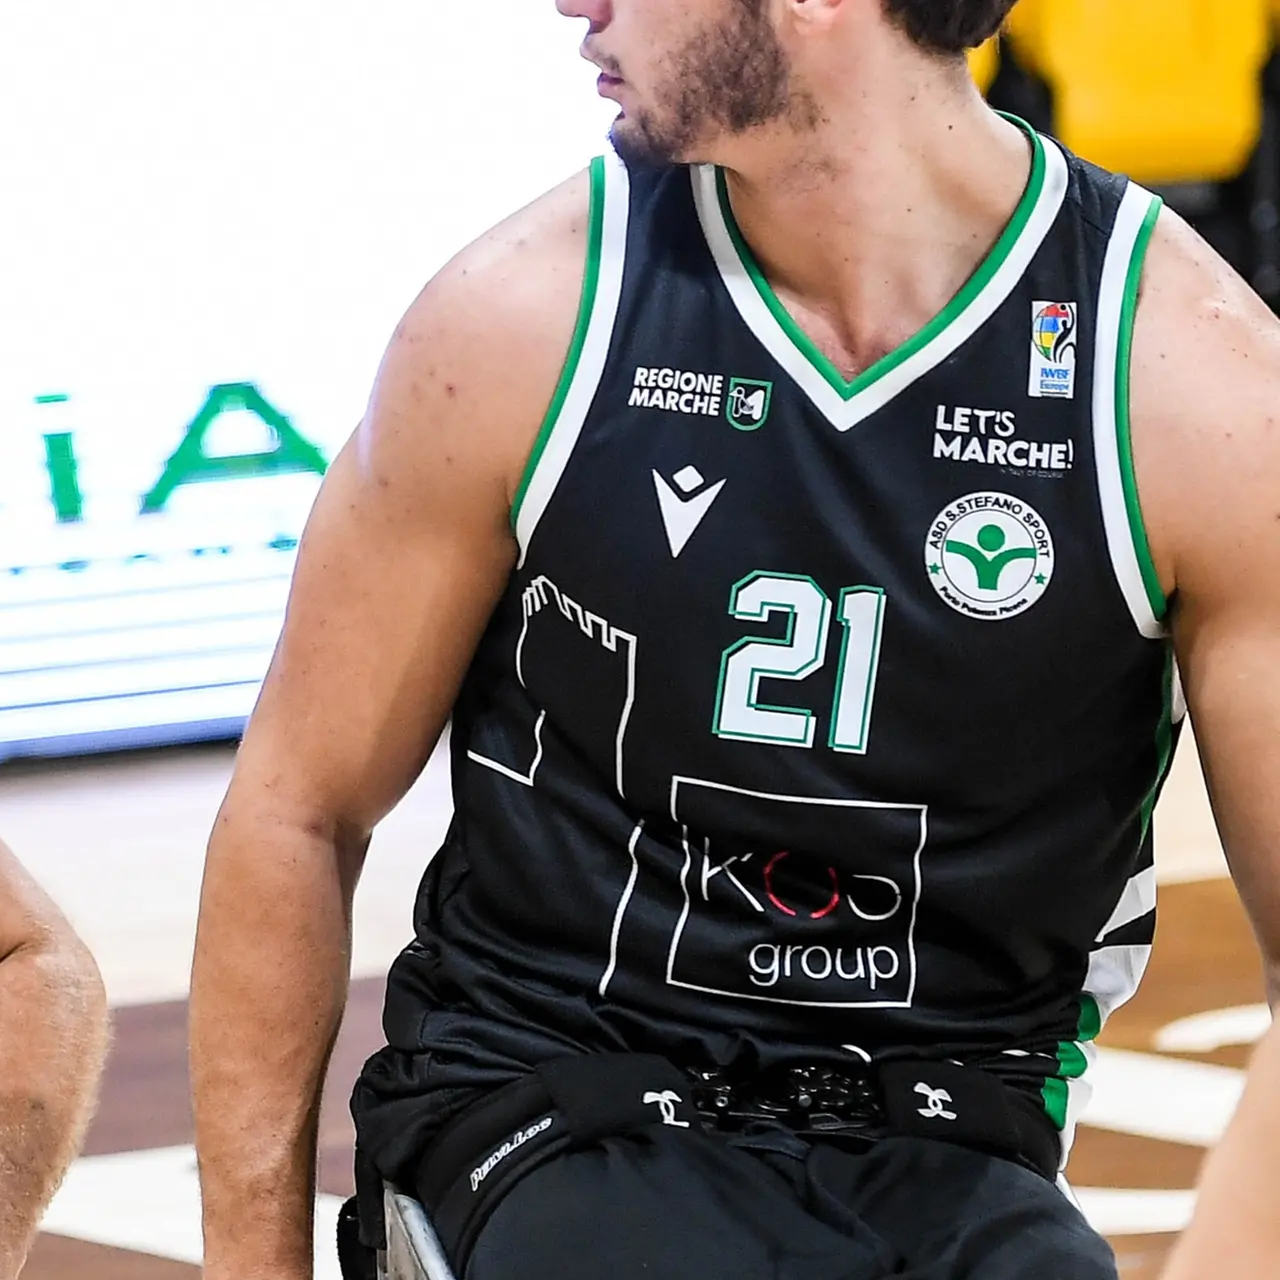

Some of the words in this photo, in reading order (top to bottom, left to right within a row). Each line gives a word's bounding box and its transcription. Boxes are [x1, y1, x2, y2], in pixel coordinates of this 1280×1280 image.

[634, 367, 723, 395] REGIONE
[628, 388, 720, 416] MARCHE
[936, 405, 1015, 437] LET'S
[933, 439, 1074, 470] MARCHE!
[929, 520, 948, 549] ASD
[1023, 513, 1050, 558] SPORT
[712, 570, 887, 755] 21
[749, 944, 899, 990] group
